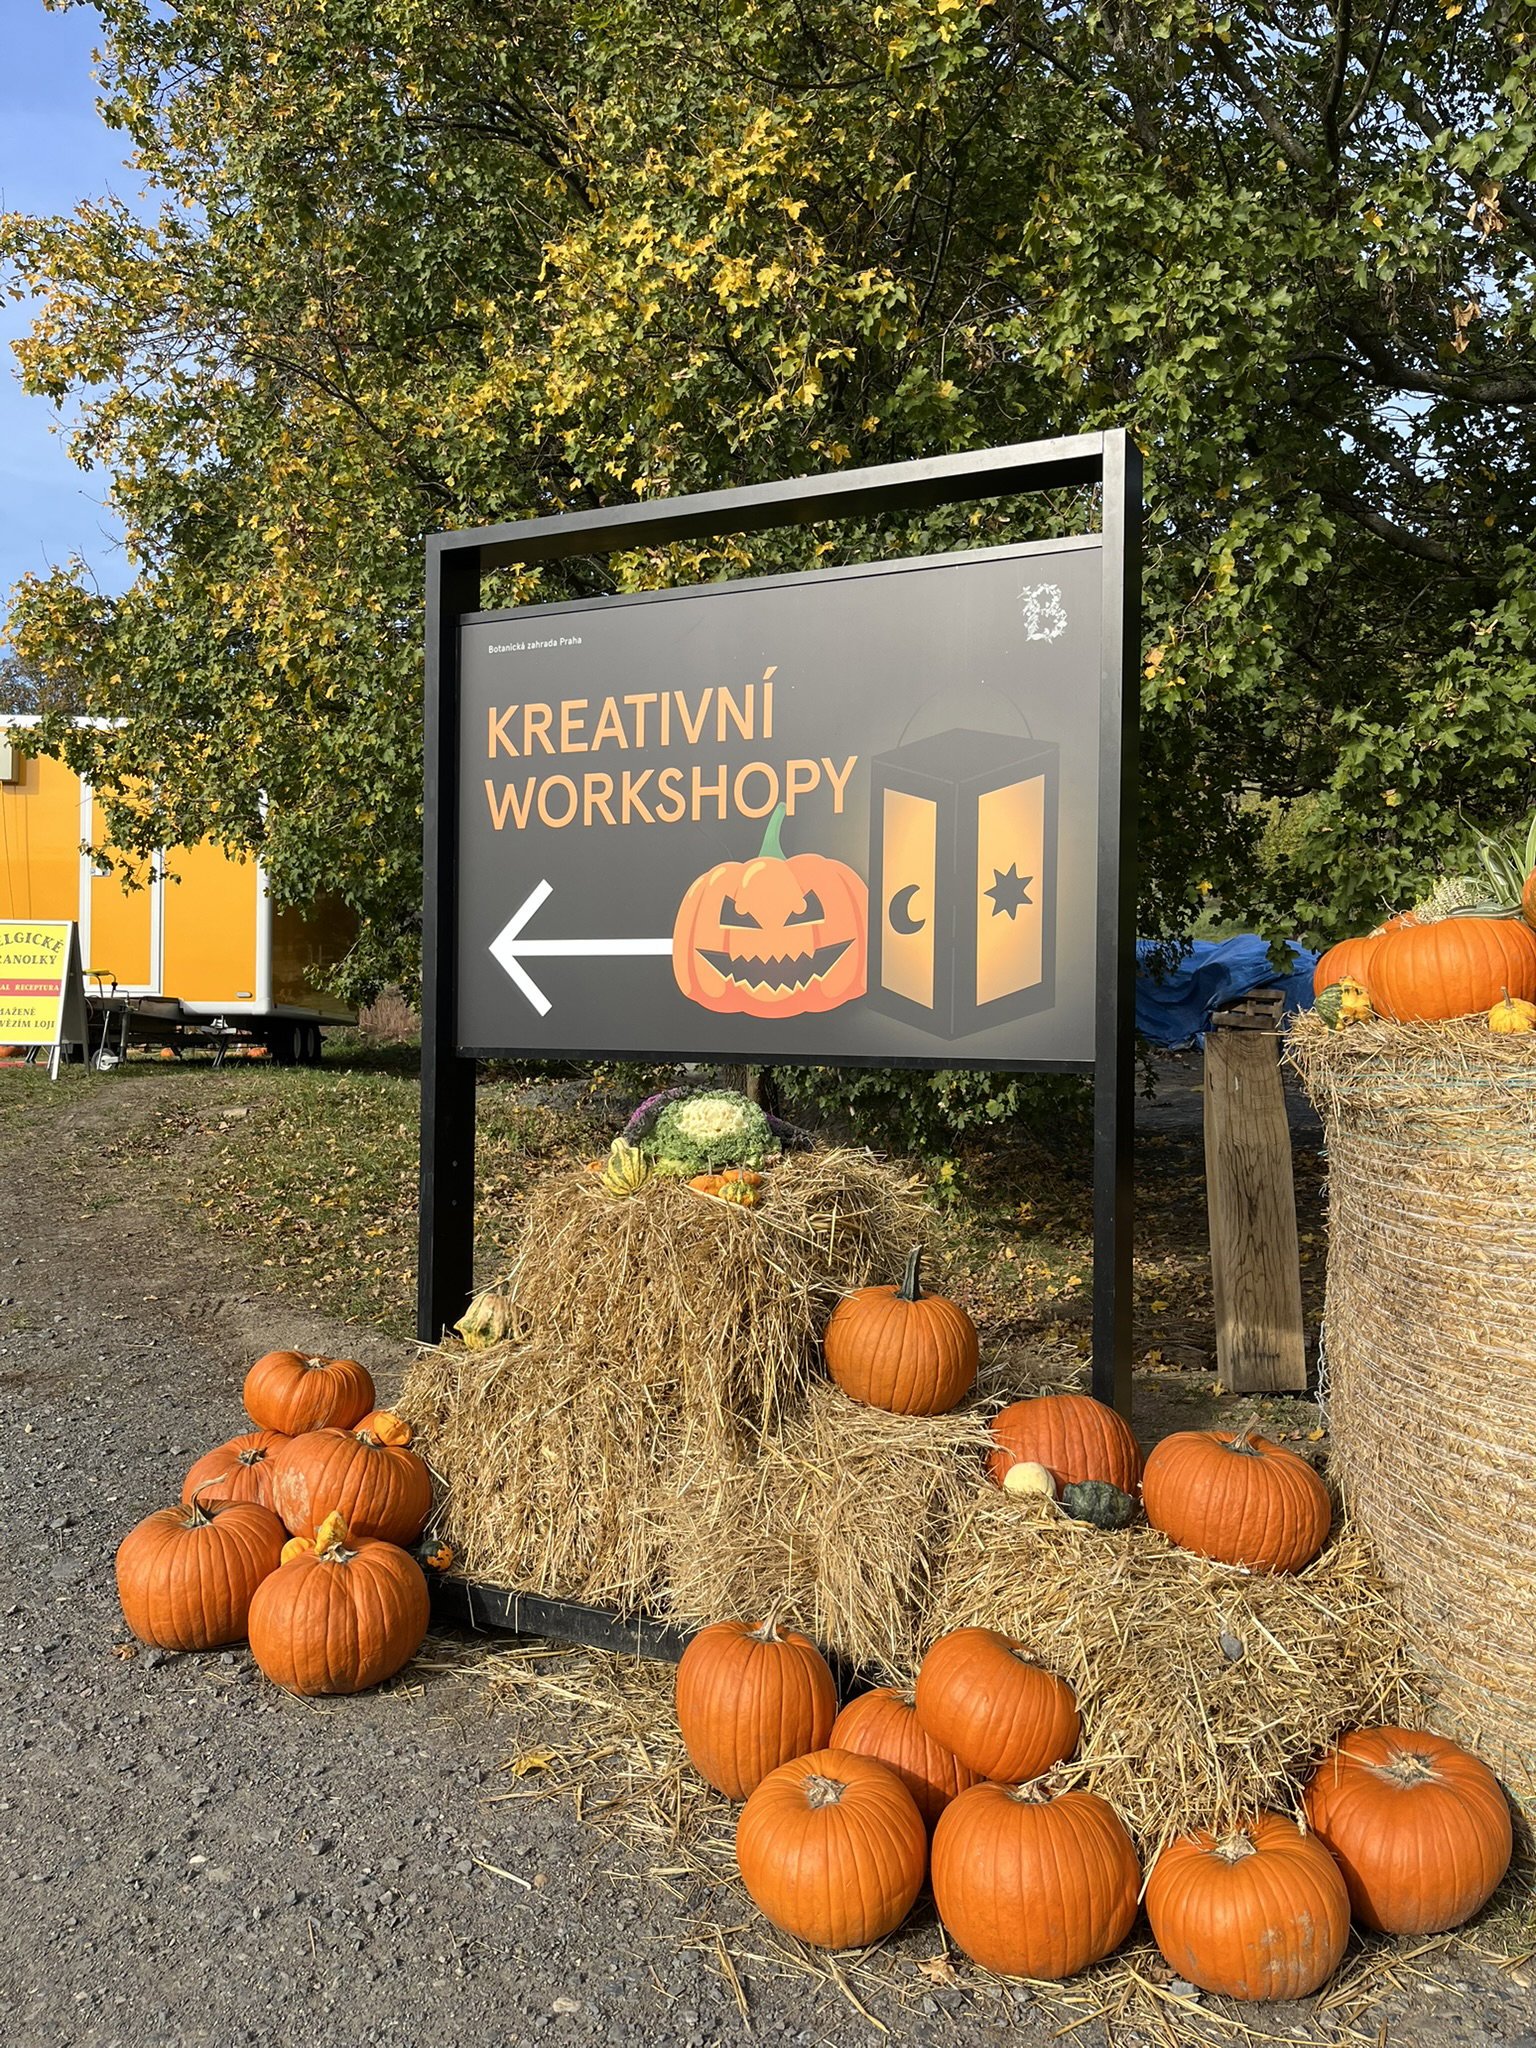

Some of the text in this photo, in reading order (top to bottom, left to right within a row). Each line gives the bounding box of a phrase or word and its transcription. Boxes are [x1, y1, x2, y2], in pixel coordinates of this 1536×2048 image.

[488, 636, 583, 654] Botanická zahrada Praha
[488, 665, 778, 758] KREATIVNÍ
[484, 755, 858, 830] WORKSHOPY
[0, 955, 57, 964] ANOLKY
[35, 1021, 55, 1030] LOJI
